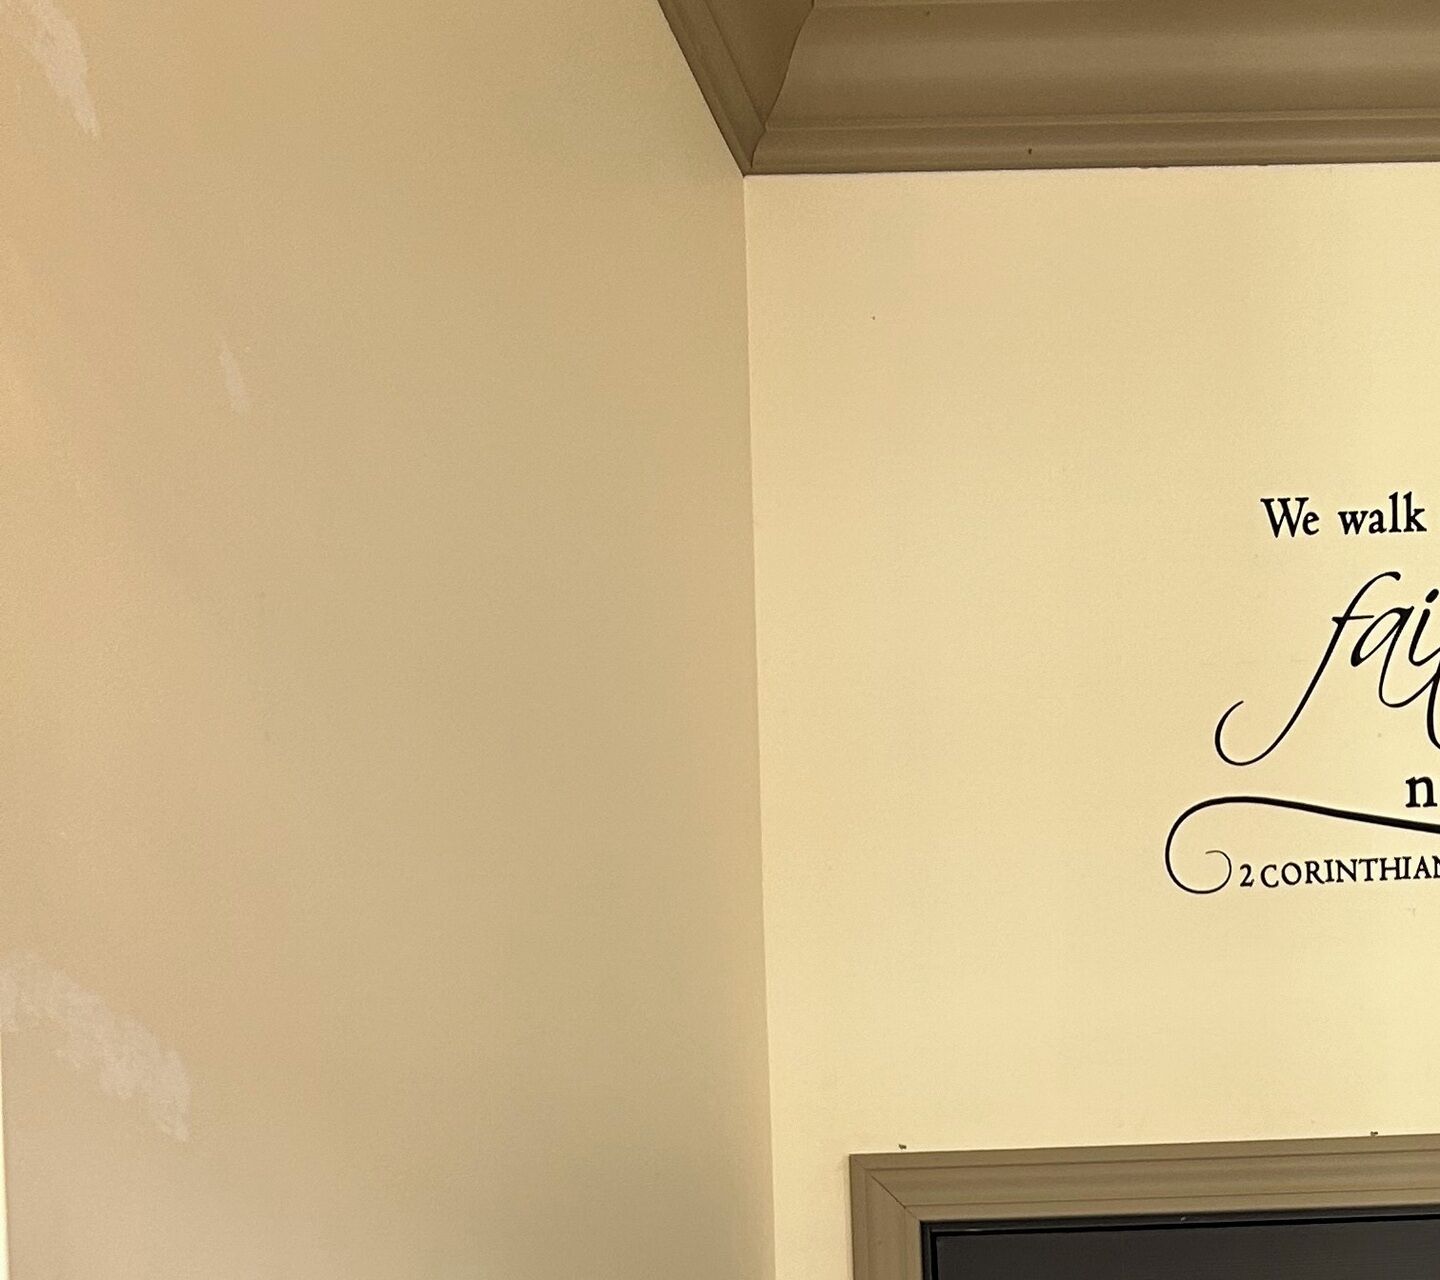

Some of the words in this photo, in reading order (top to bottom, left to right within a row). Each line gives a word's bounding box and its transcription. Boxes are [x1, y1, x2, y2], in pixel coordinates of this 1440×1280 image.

[1260, 496, 1320, 539] We
[1337, 491, 1428, 535] walk
[1239, 863, 1255, 888] 2
